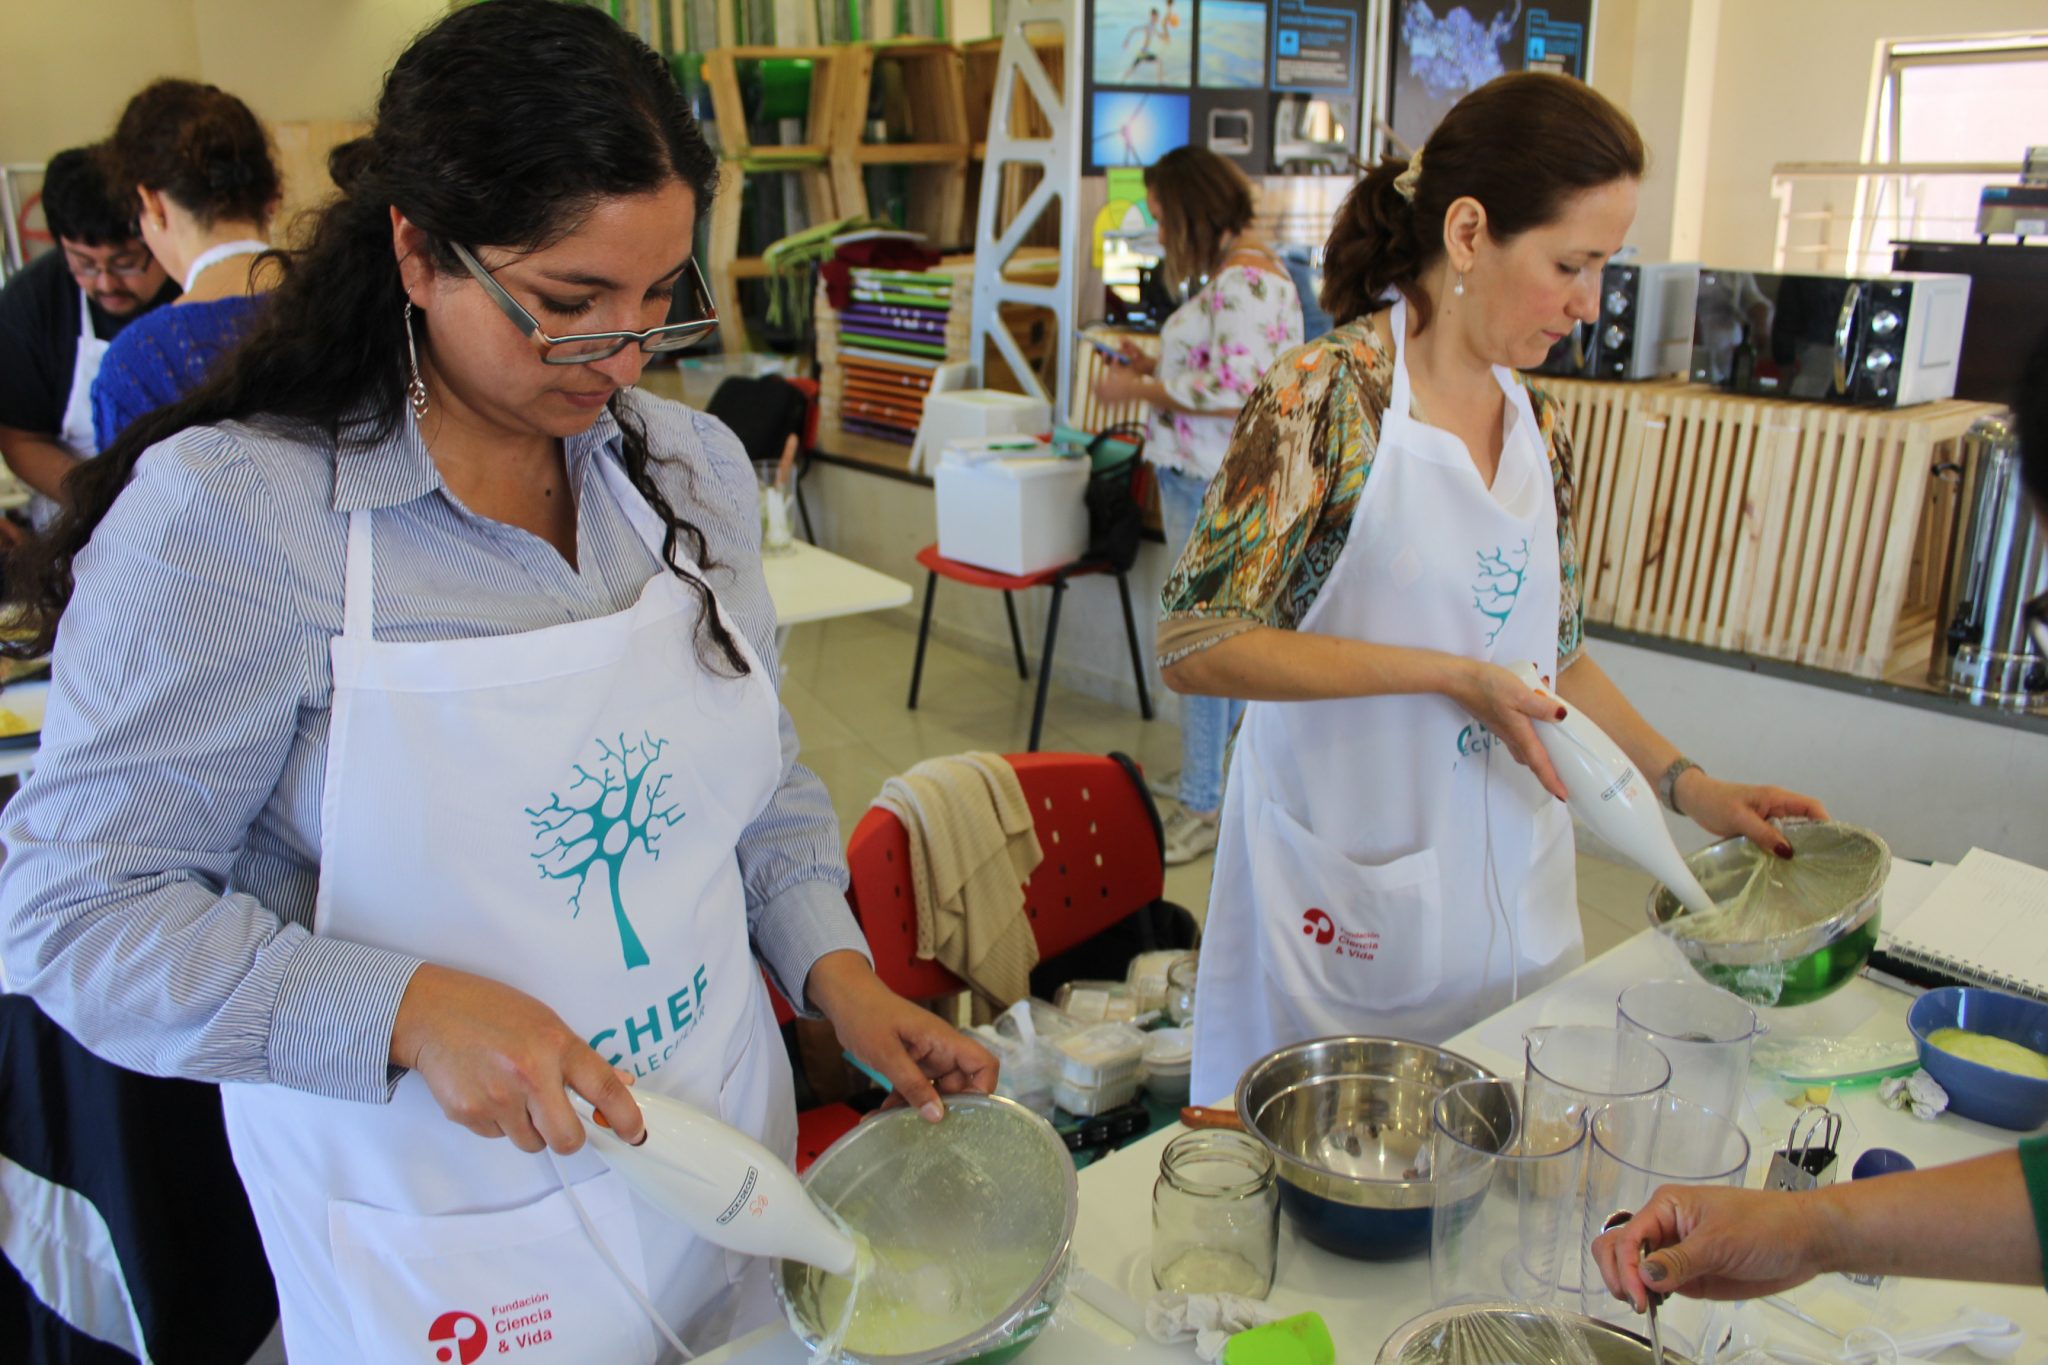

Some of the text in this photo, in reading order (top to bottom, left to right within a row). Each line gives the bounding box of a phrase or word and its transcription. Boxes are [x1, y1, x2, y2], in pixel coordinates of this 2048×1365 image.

[1336, 946, 1374, 960] & Vida
[1338, 935, 1378, 949] Ciencia
[588, 963, 709, 1067] CHEF
[491, 1292, 549, 1316] Fundación
[495, 1308, 553, 1334] Ciencia
[498, 1329, 553, 1354] & Vida
